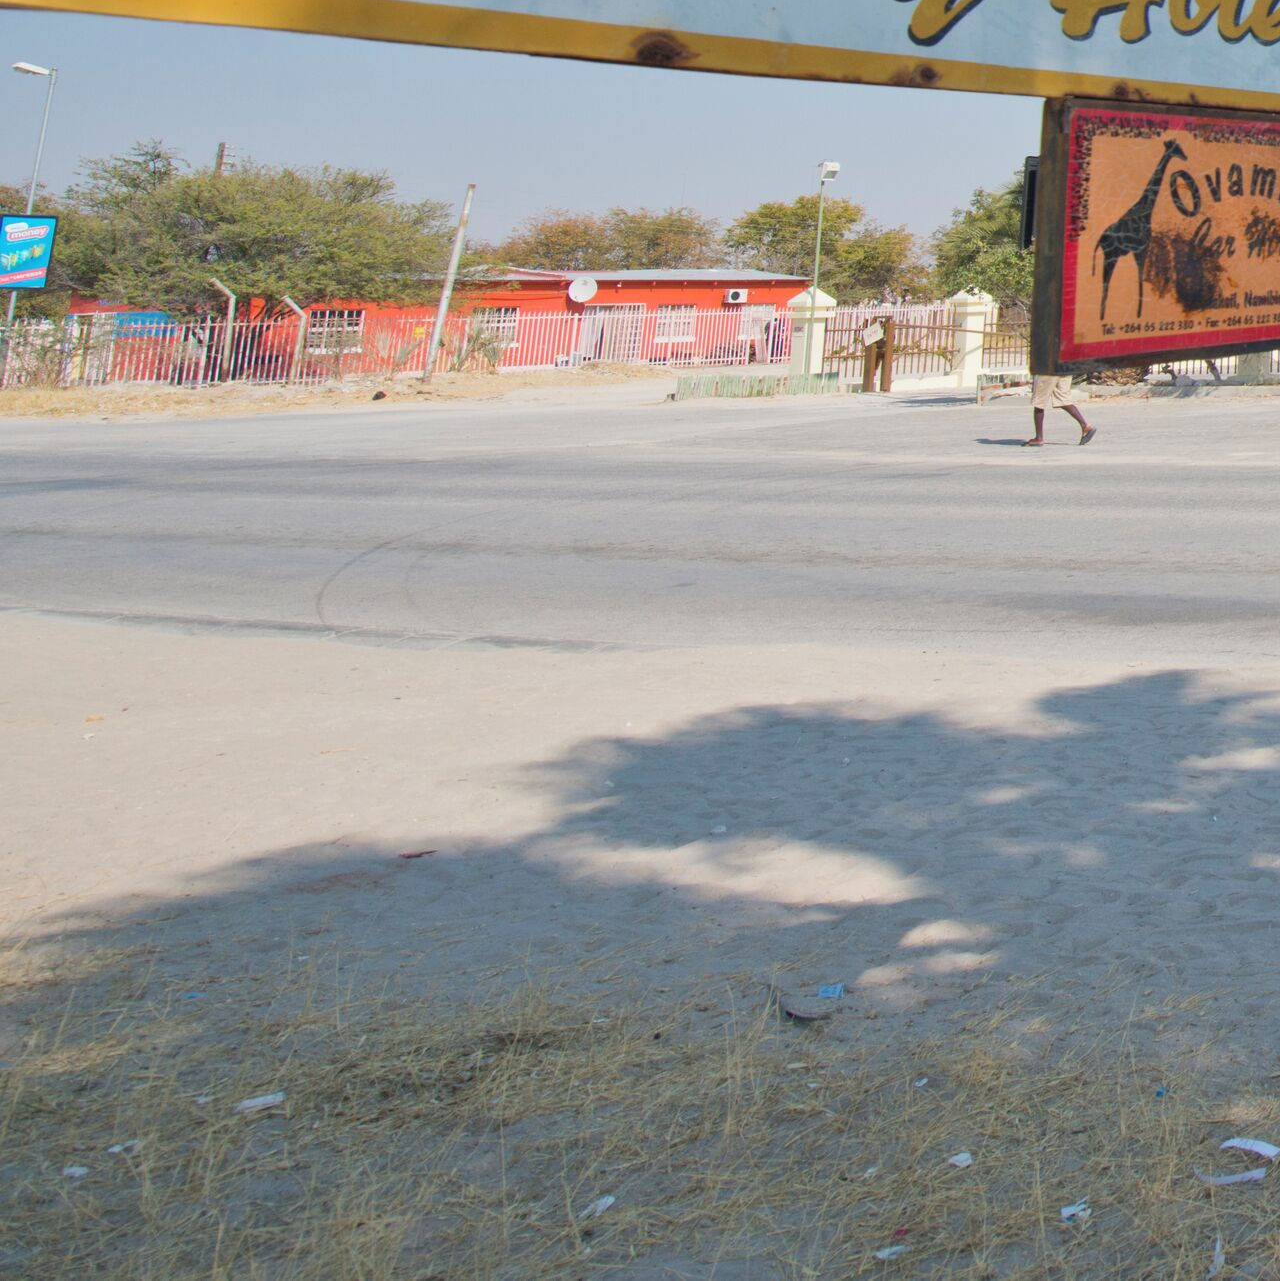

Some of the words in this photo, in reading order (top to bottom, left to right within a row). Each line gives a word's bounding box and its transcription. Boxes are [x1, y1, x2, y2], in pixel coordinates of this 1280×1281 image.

[1101, 323, 1115, 335] Tel:
[1119, 323, 1141, 333] +264
[1144, 322, 1155, 332] 65
[1159, 321, 1175, 331] 222
[1222, 316, 1241, 326] +264
